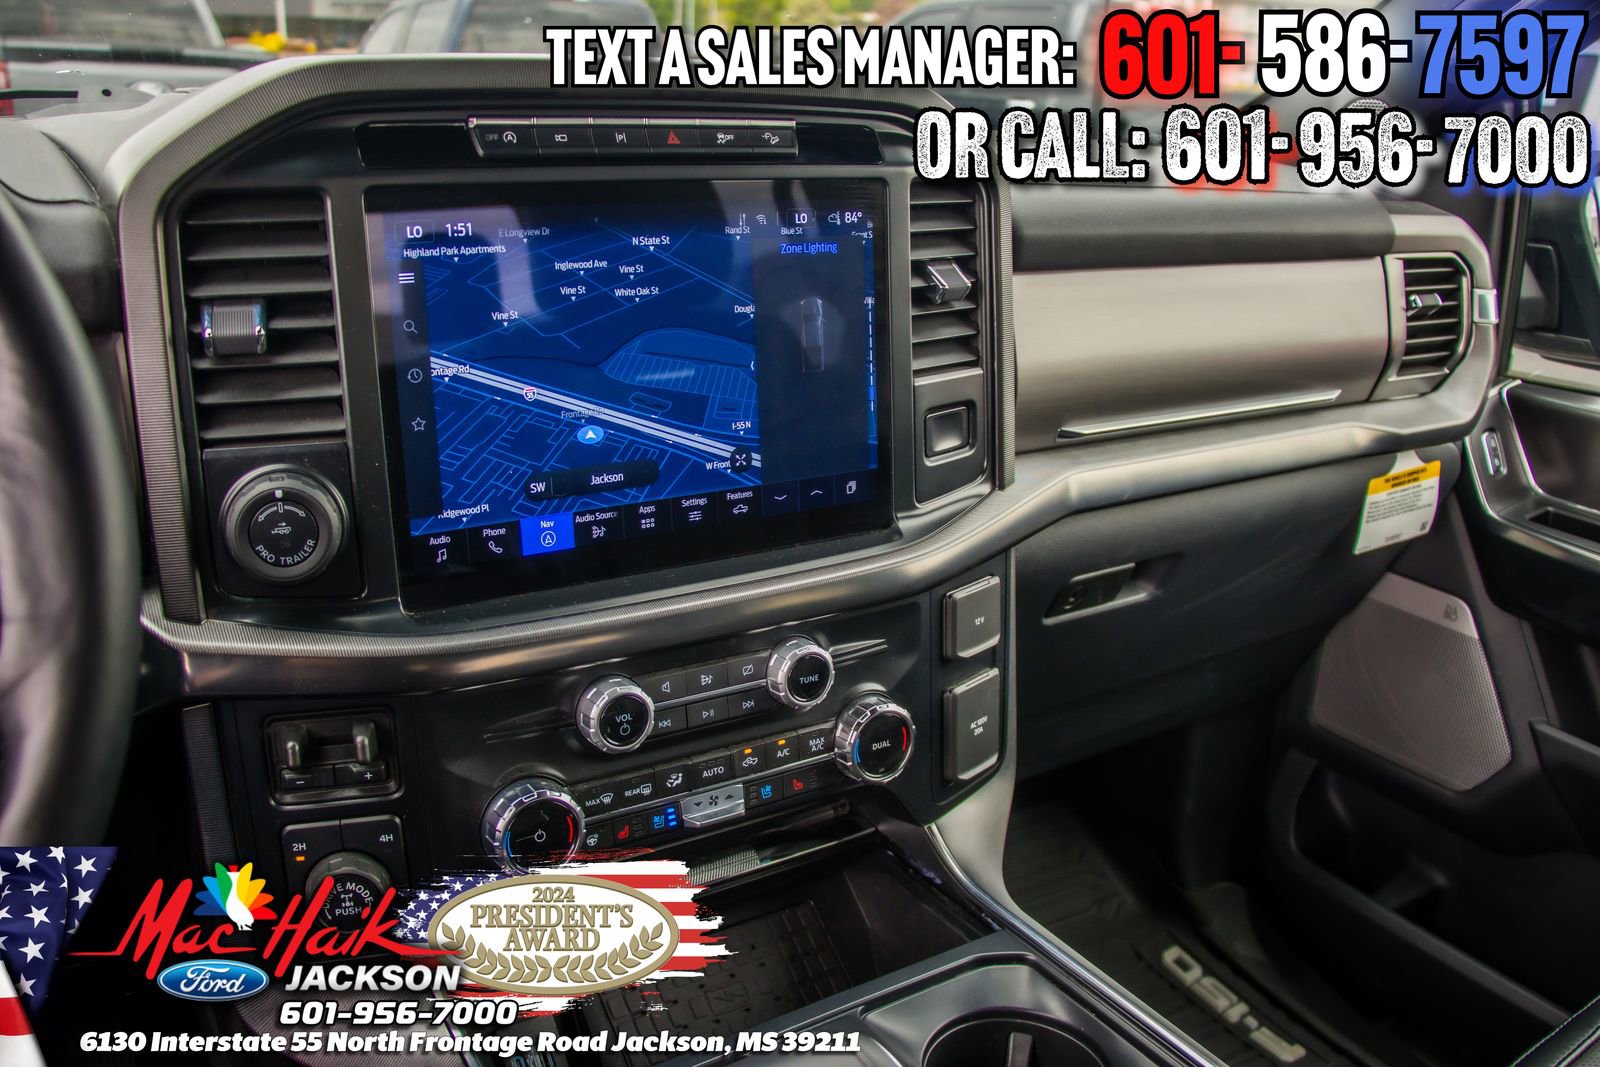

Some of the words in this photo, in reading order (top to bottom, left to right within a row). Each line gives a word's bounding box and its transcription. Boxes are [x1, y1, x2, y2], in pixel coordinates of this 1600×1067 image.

[795, 212, 808, 224] LO
[406, 225, 423, 239] LO
[445, 222, 473, 238] 1:51
[504, 227, 541, 238] Longview
[725, 225, 740, 234] Rand
[740, 224, 750, 234] St
[781, 227, 795, 235] Blue
[795, 226, 803, 235] St
[632, 237, 640, 246] N
[640, 236, 659, 246] State
[659, 235, 670, 245] St
[403, 247, 440, 258] Highland
[440, 246, 459, 256] Park
[459, 244, 507, 256] Apartments
[781, 243, 803, 254] Zone
[803, 242, 838, 256] Lighting
[555, 260, 593, 271] Inglewood
[594, 259, 608, 268] Ave
[619, 265, 635, 274] Vine
[635, 264, 644, 273] St
[560, 286, 576, 295] Vine
[576, 285, 587, 294] St
[614, 288, 635, 297] White
[636, 287, 650, 296] Oak
[650, 286, 659, 296] St
[491, 311, 508, 321] Vine
[508, 310, 519, 320] St
[458, 364, 470, 373] Rd
[561, 409, 592, 419] Frontage
[732, 421, 746, 430] I-55
[705, 462, 713, 470] W
[590, 473, 624, 486] Jackson
[530, 483, 546, 493] SW
[727, 490, 753, 501] Features
[681, 497, 708, 508] Settings
[481, 503, 490, 513] Pl
[639, 504, 656, 514] Apps
[575, 513, 596, 523] Audio
[541, 520, 555, 529] Nav
[483, 527, 507, 537] Phone
[430, 536, 451, 545] Audio
[255, 545, 276, 563] PRO
[280, 539, 316, 566] TRAILER
[800, 674, 819, 684] TUNE
[615, 713, 633, 724] VOL
[809, 737, 825, 747] MAX
[872, 739, 891, 751] DUAL
[777, 748, 790, 759] A/C
[811, 744, 824, 753] A/C
[702, 766, 725, 778] AUTO
[624, 788, 641, 797] REAR
[585, 798, 601, 807] MAX
[379, 834, 394, 843] 4H
[292, 843, 307, 851] 2H
[345, 882, 374, 904] MODE
[1160, 944, 1307, 1063] F-150
